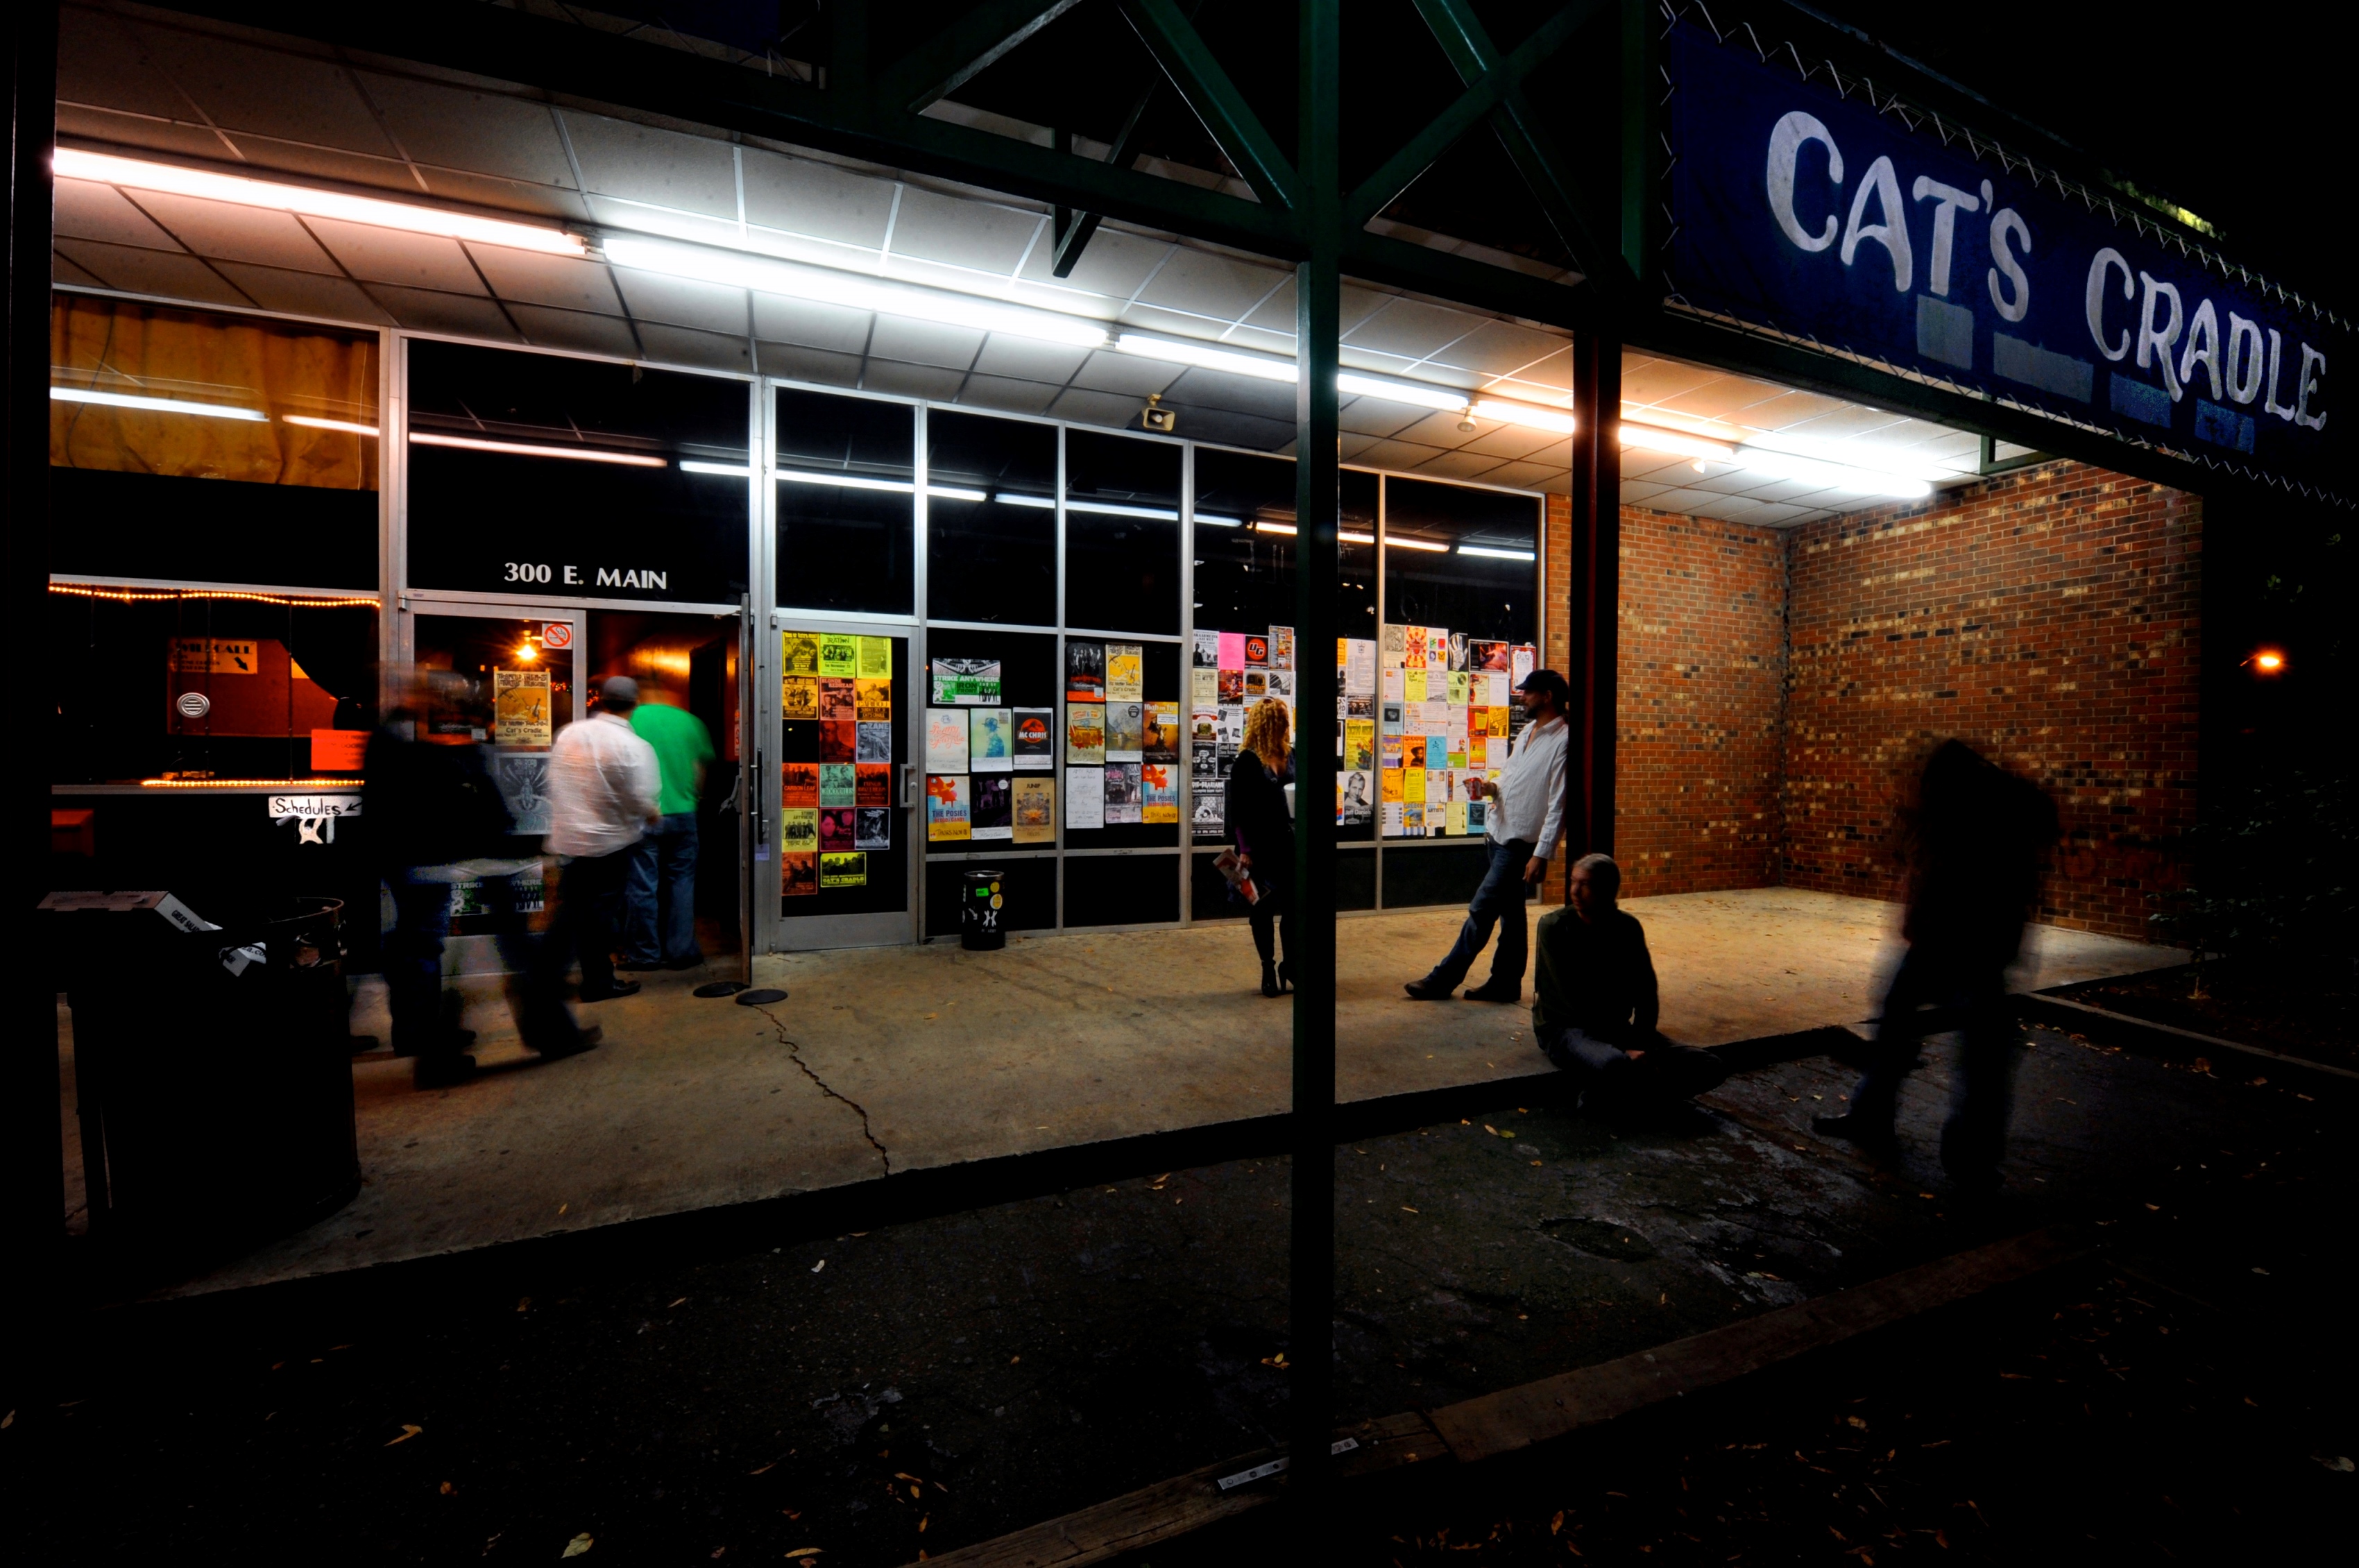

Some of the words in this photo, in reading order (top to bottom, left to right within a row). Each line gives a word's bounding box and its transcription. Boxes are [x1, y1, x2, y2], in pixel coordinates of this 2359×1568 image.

[1766, 110, 2031, 322] CAT'S
[2086, 248, 2327, 430] CRADLE
[504, 563, 552, 583] 300
[563, 565, 584, 585] E.
[596, 567, 667, 590] MAIN
[171, 910, 188, 924] GREAT
